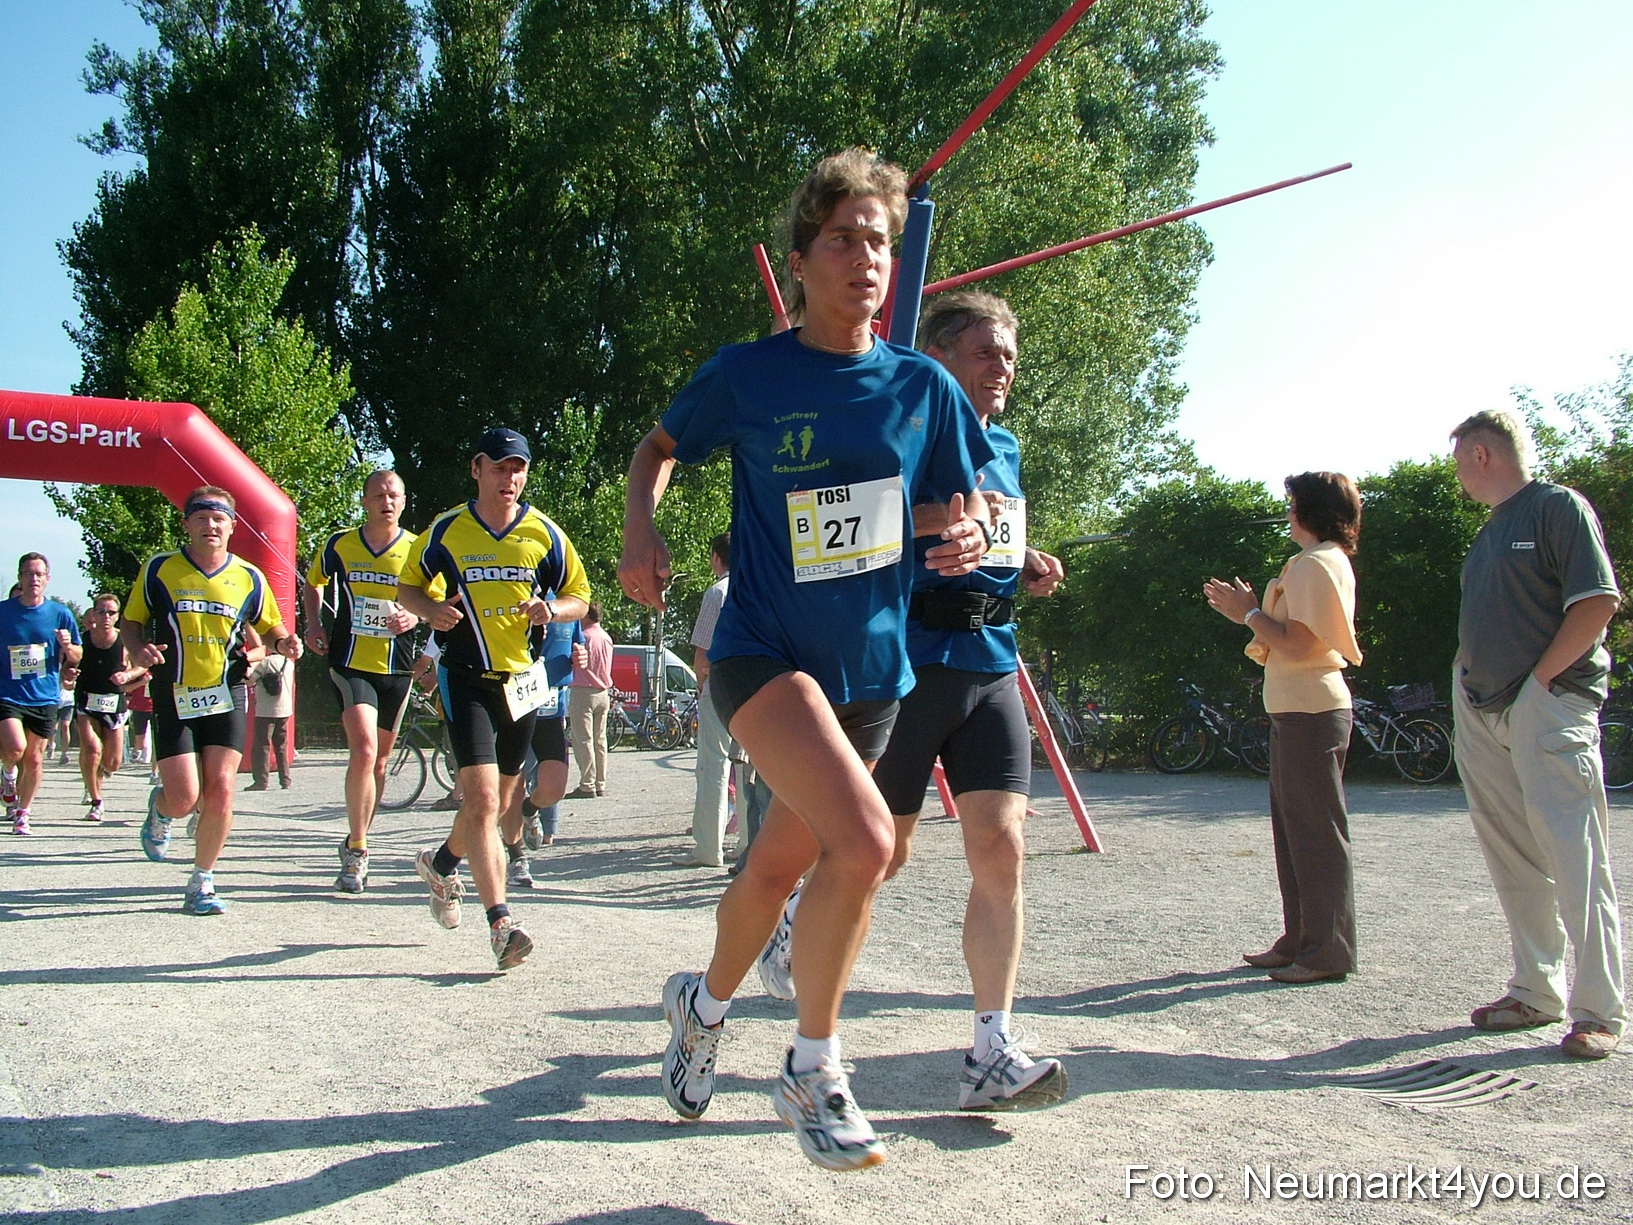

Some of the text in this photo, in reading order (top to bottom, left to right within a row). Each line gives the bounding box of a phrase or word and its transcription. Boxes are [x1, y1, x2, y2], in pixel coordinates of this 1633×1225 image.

[773, 411, 819, 424] Lauftreff
[7, 418, 142, 449] LGS-Park
[772, 458, 830, 473] Schwandorf
[796, 517, 810, 534] B
[823, 515, 862, 550] 27
[461, 554, 497, 563] TEAM
[463, 565, 535, 584] BOCK
[796, 561, 844, 577] BOCK
[348, 570, 399, 587] BOCK
[175, 598, 238, 620] BOCK
[364, 614, 388, 628] 343
[20, 658, 38, 667] 860
[516, 679, 538, 701] 814
[96, 698, 115, 707] 1026
[190, 694, 219, 709] 812
